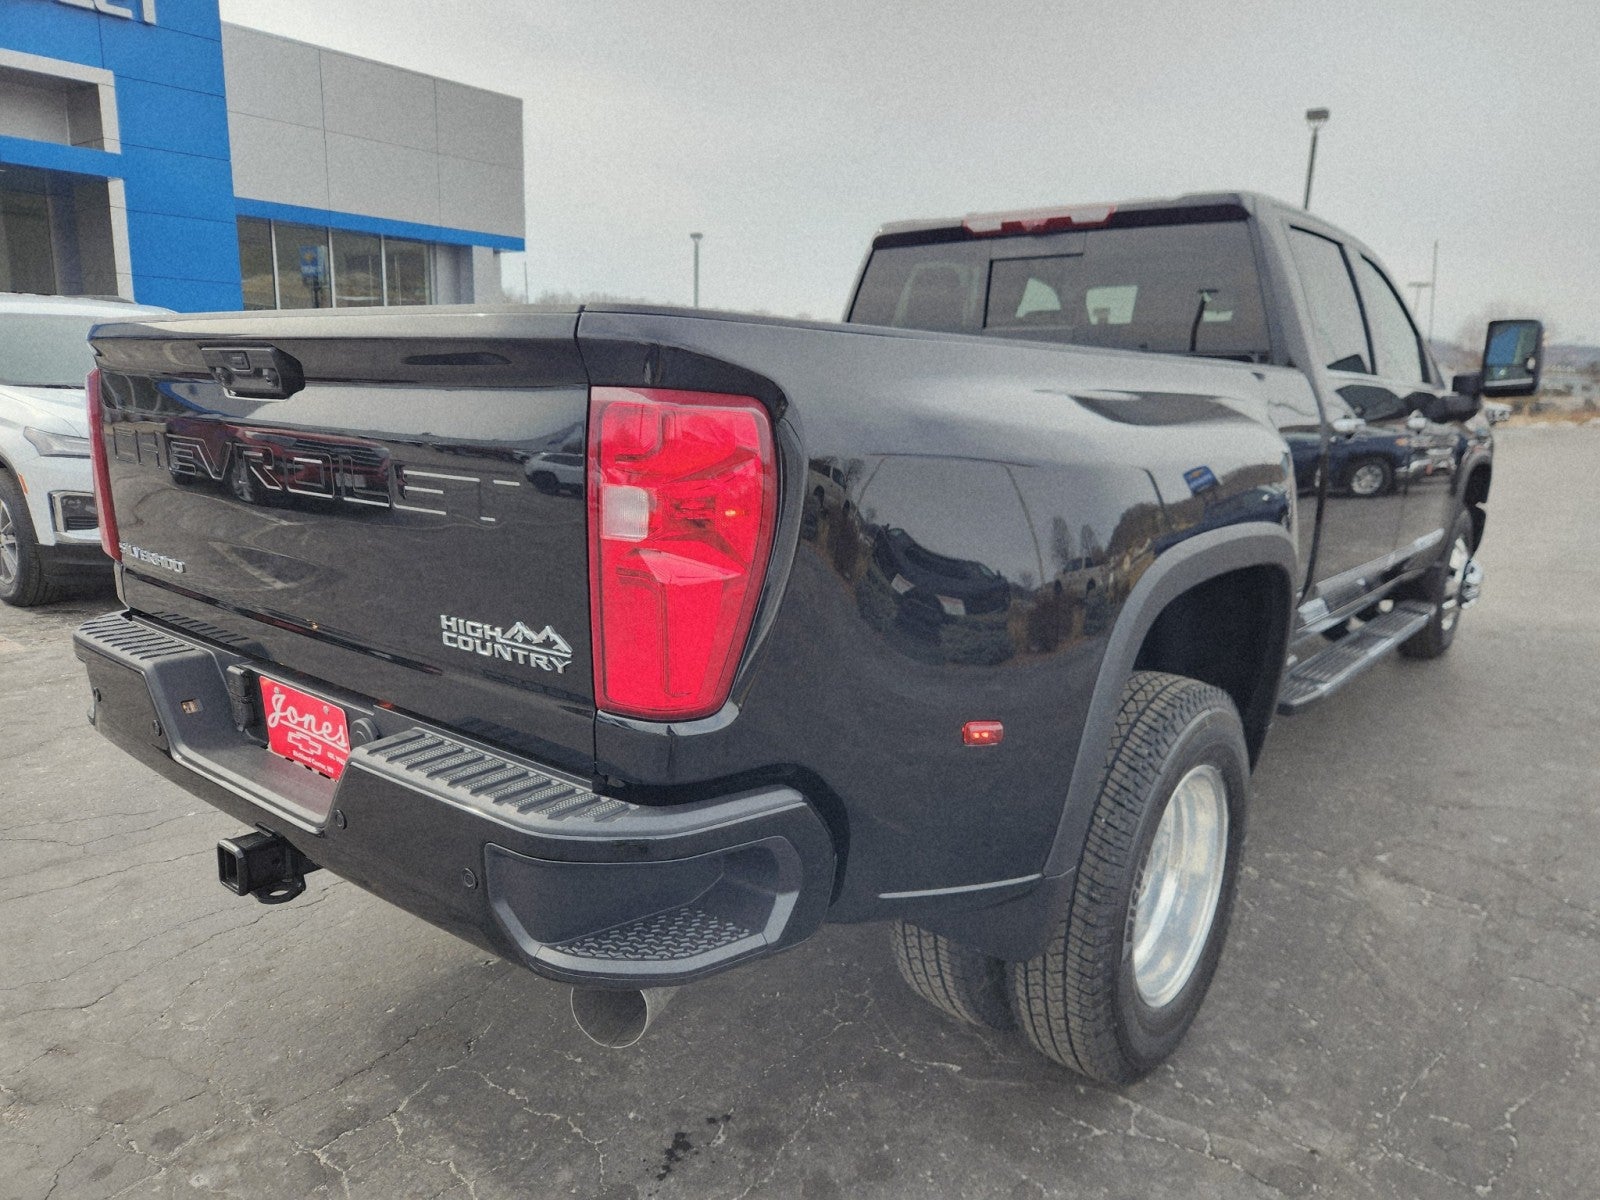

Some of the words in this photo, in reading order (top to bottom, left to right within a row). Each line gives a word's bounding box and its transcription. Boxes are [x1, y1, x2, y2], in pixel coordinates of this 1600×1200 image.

[111, 425, 520, 522] CHEVROLET
[440, 614, 503, 642] HIGH
[442, 631, 572, 674] COUNTRY
[268, 694, 347, 747] Jones
